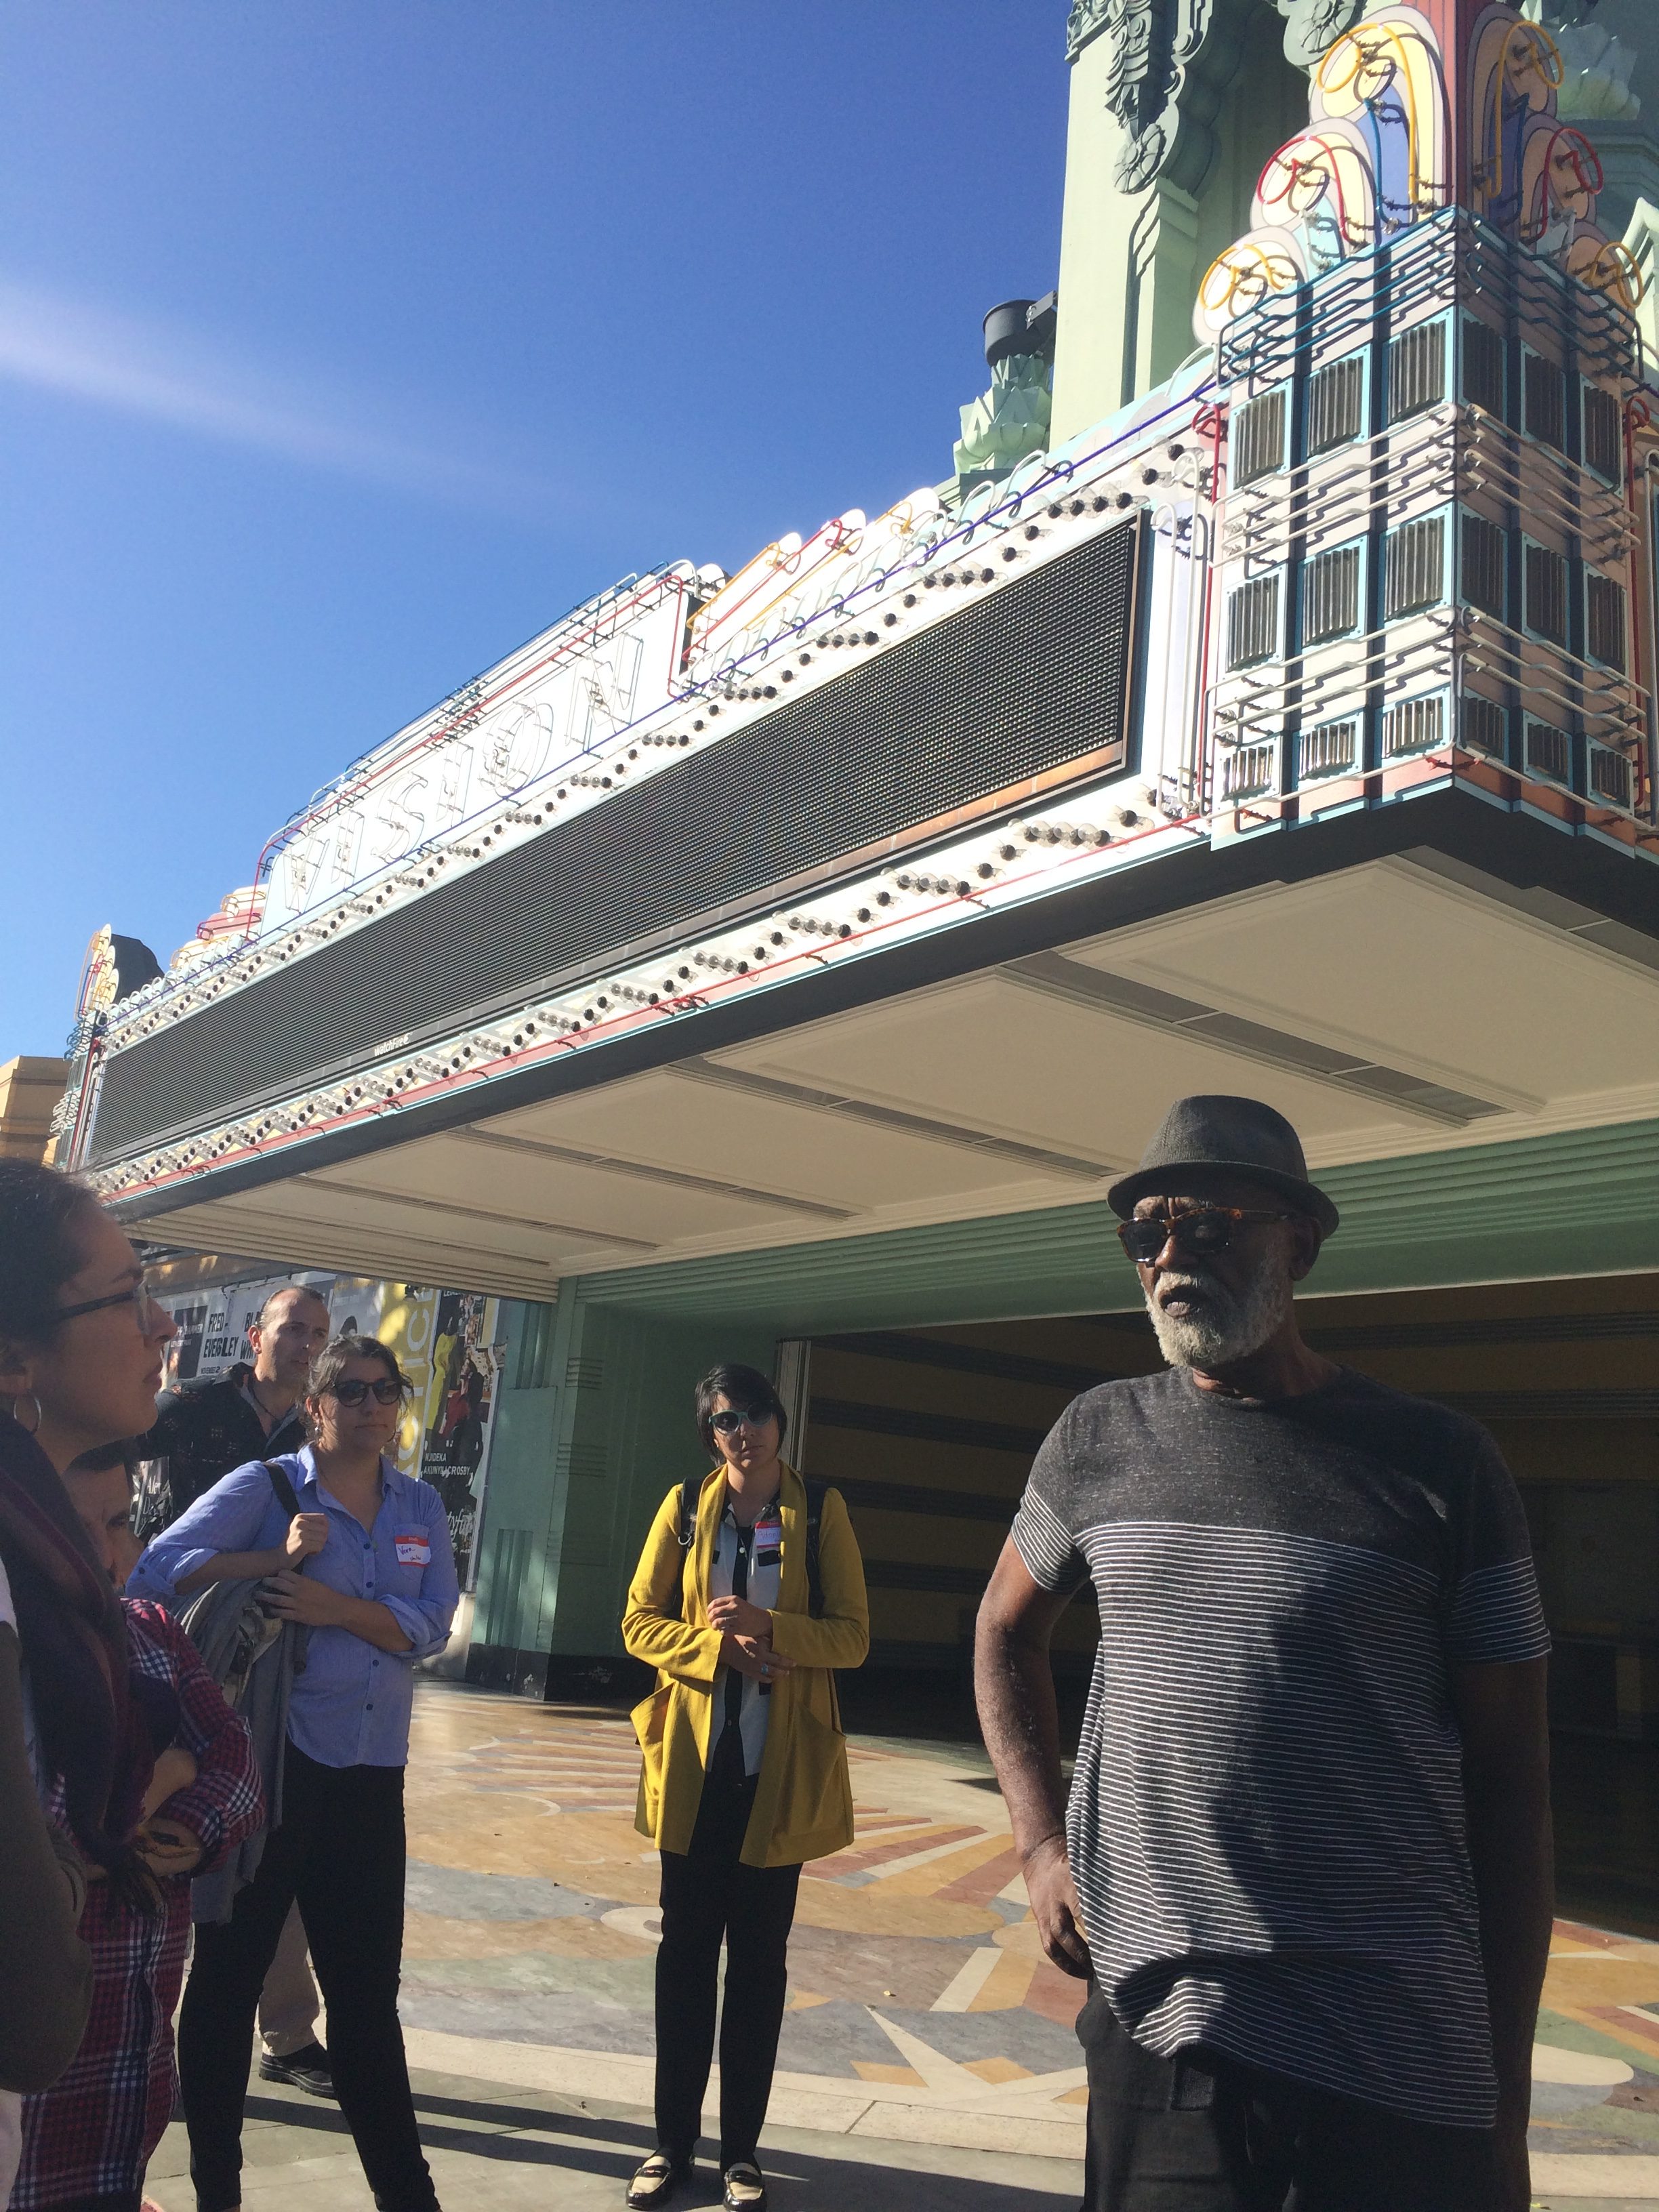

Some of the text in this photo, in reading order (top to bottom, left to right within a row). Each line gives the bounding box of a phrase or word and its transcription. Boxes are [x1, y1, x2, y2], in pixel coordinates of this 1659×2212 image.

[208, 1312, 224, 1333] FRED
[425, 1453, 447, 1461] NJIDEKA
[447, 1466, 470, 1475] CROSBY
